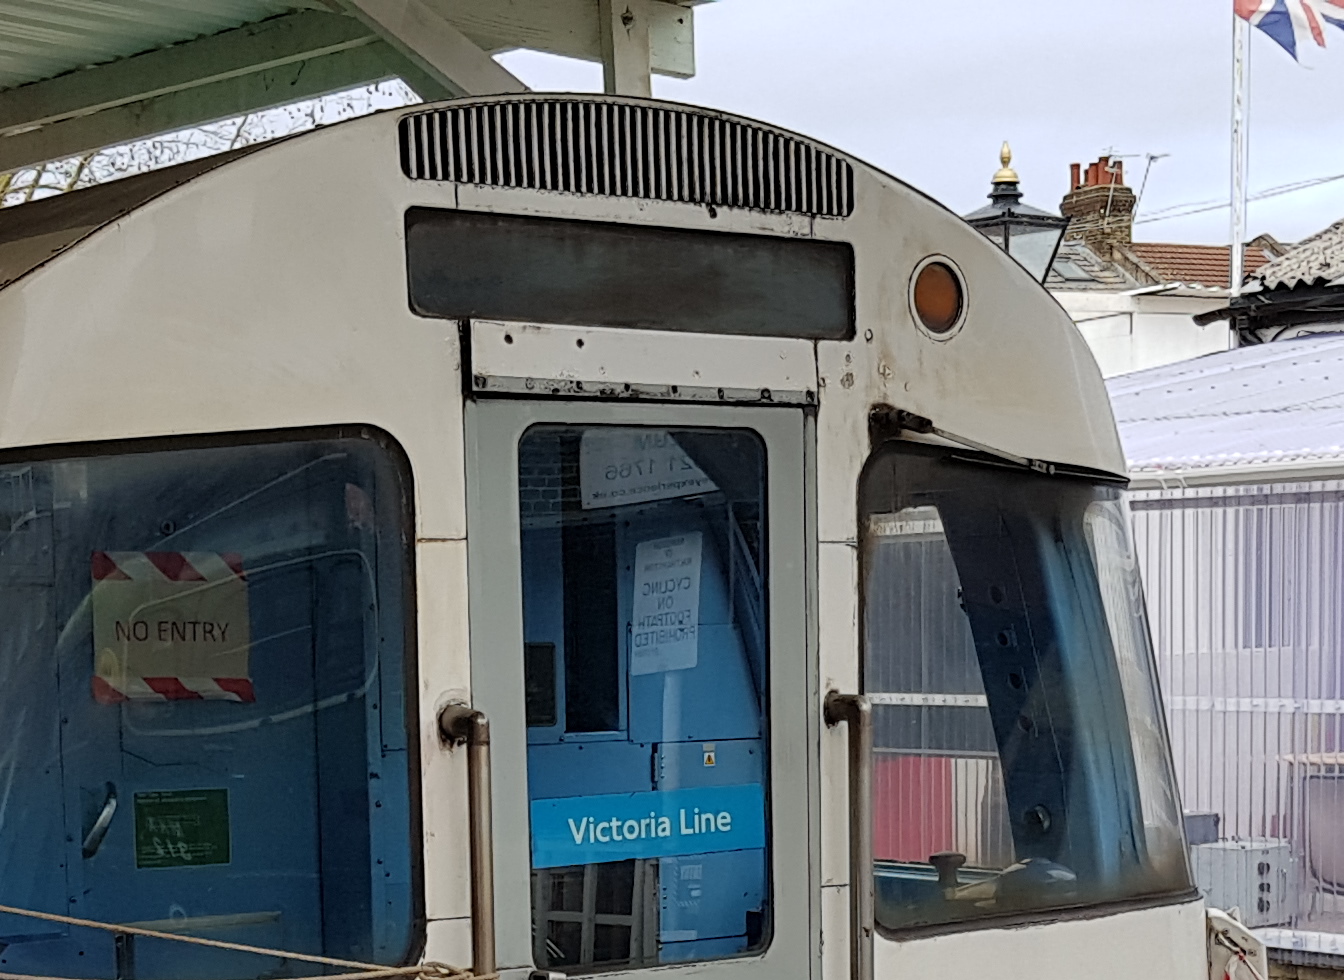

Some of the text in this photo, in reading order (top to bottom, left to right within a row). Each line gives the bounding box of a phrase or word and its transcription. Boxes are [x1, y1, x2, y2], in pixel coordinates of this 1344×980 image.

[115, 620, 230, 642] NO ENTRY
[567, 807, 732, 845] Victoria Line
